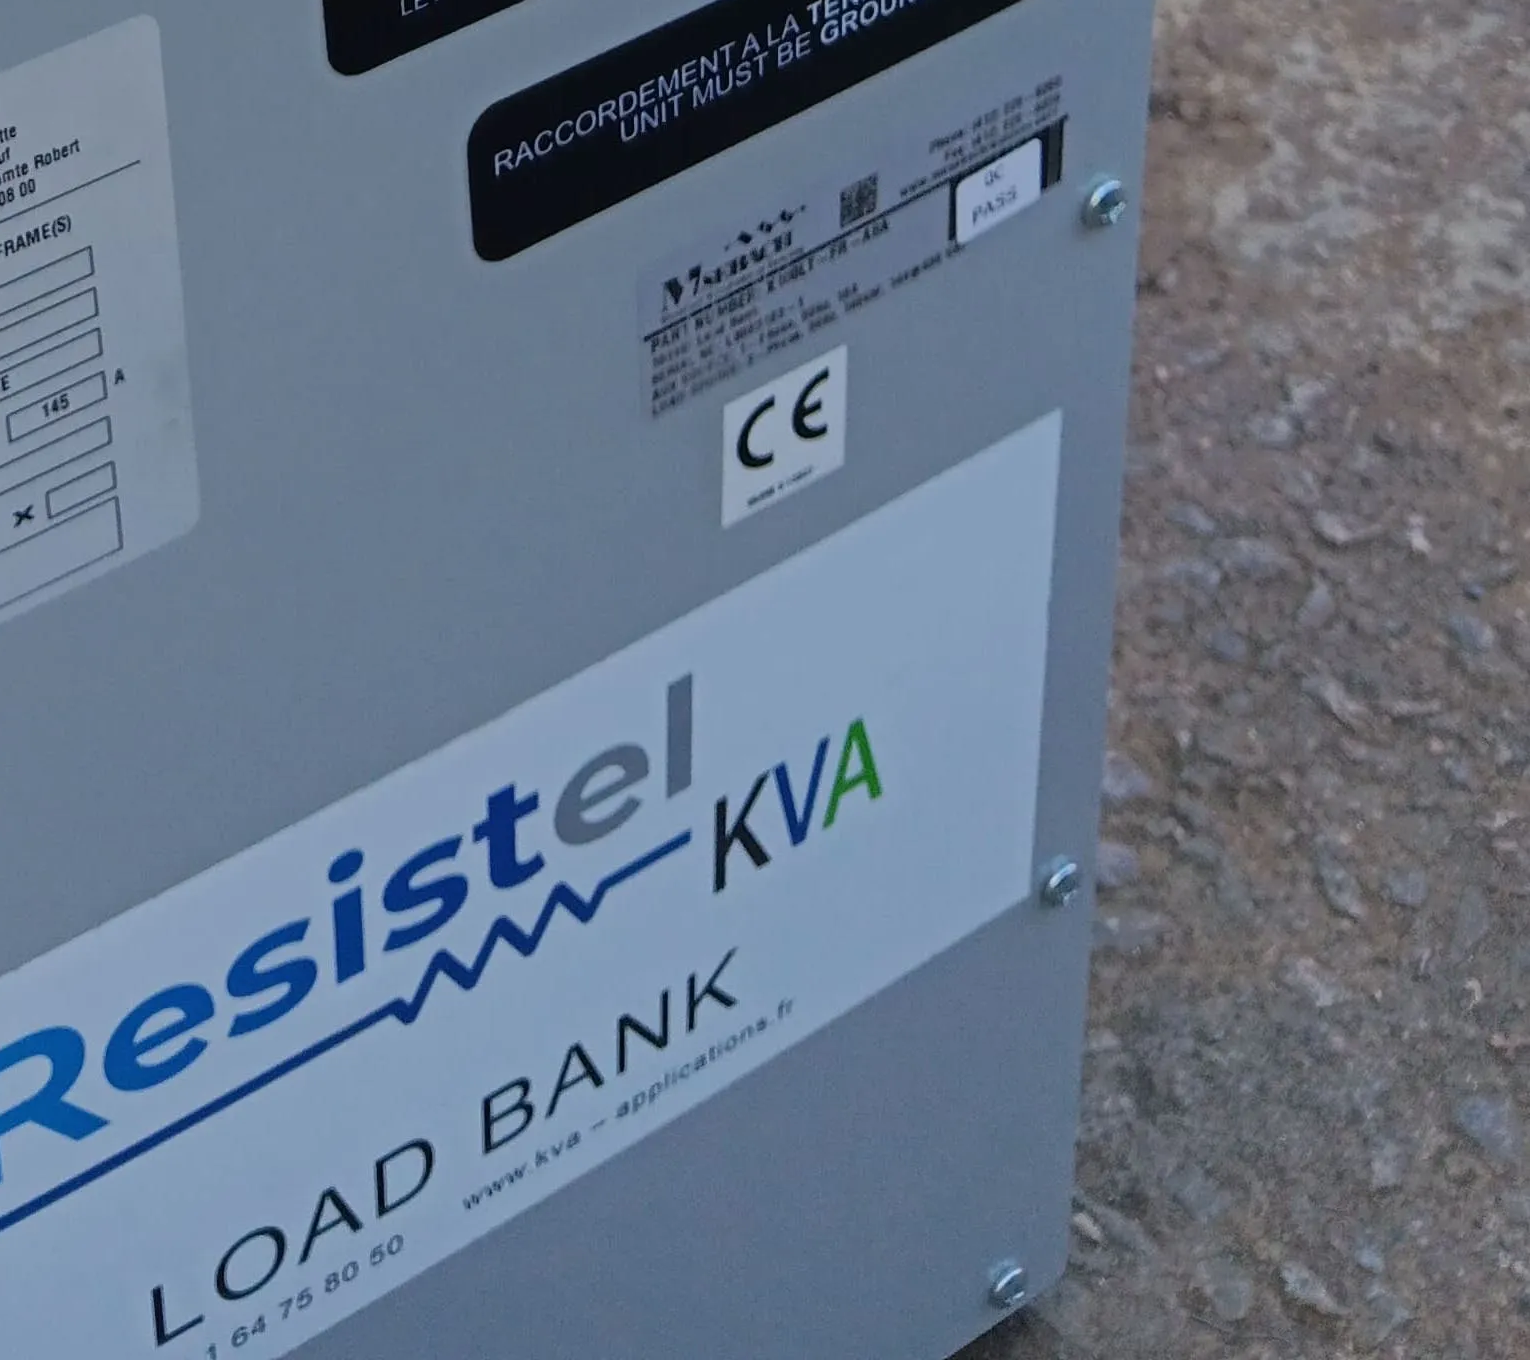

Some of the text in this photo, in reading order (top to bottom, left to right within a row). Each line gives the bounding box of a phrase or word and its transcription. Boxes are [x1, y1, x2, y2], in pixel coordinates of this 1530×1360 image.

[494, 40, 736, 177] RACCORDEMENT
[742, 32, 761, 59] A
[767, 13, 800, 47] LA
[620, 91, 685, 143] UNIT
[692, 52, 769, 110] MUST
[777, 31, 812, 69] BE
[20, 179, 36, 197] 00
[34, 138, 80, 169] Robert
[42, 368, 125, 418] 145 A
[736, 365, 830, 468] CE
[713, 718, 884, 894] KVA
[150, 946, 738, 1347] LOAD BANK
[231, 1234, 404, 1347] 64 75 80 50
